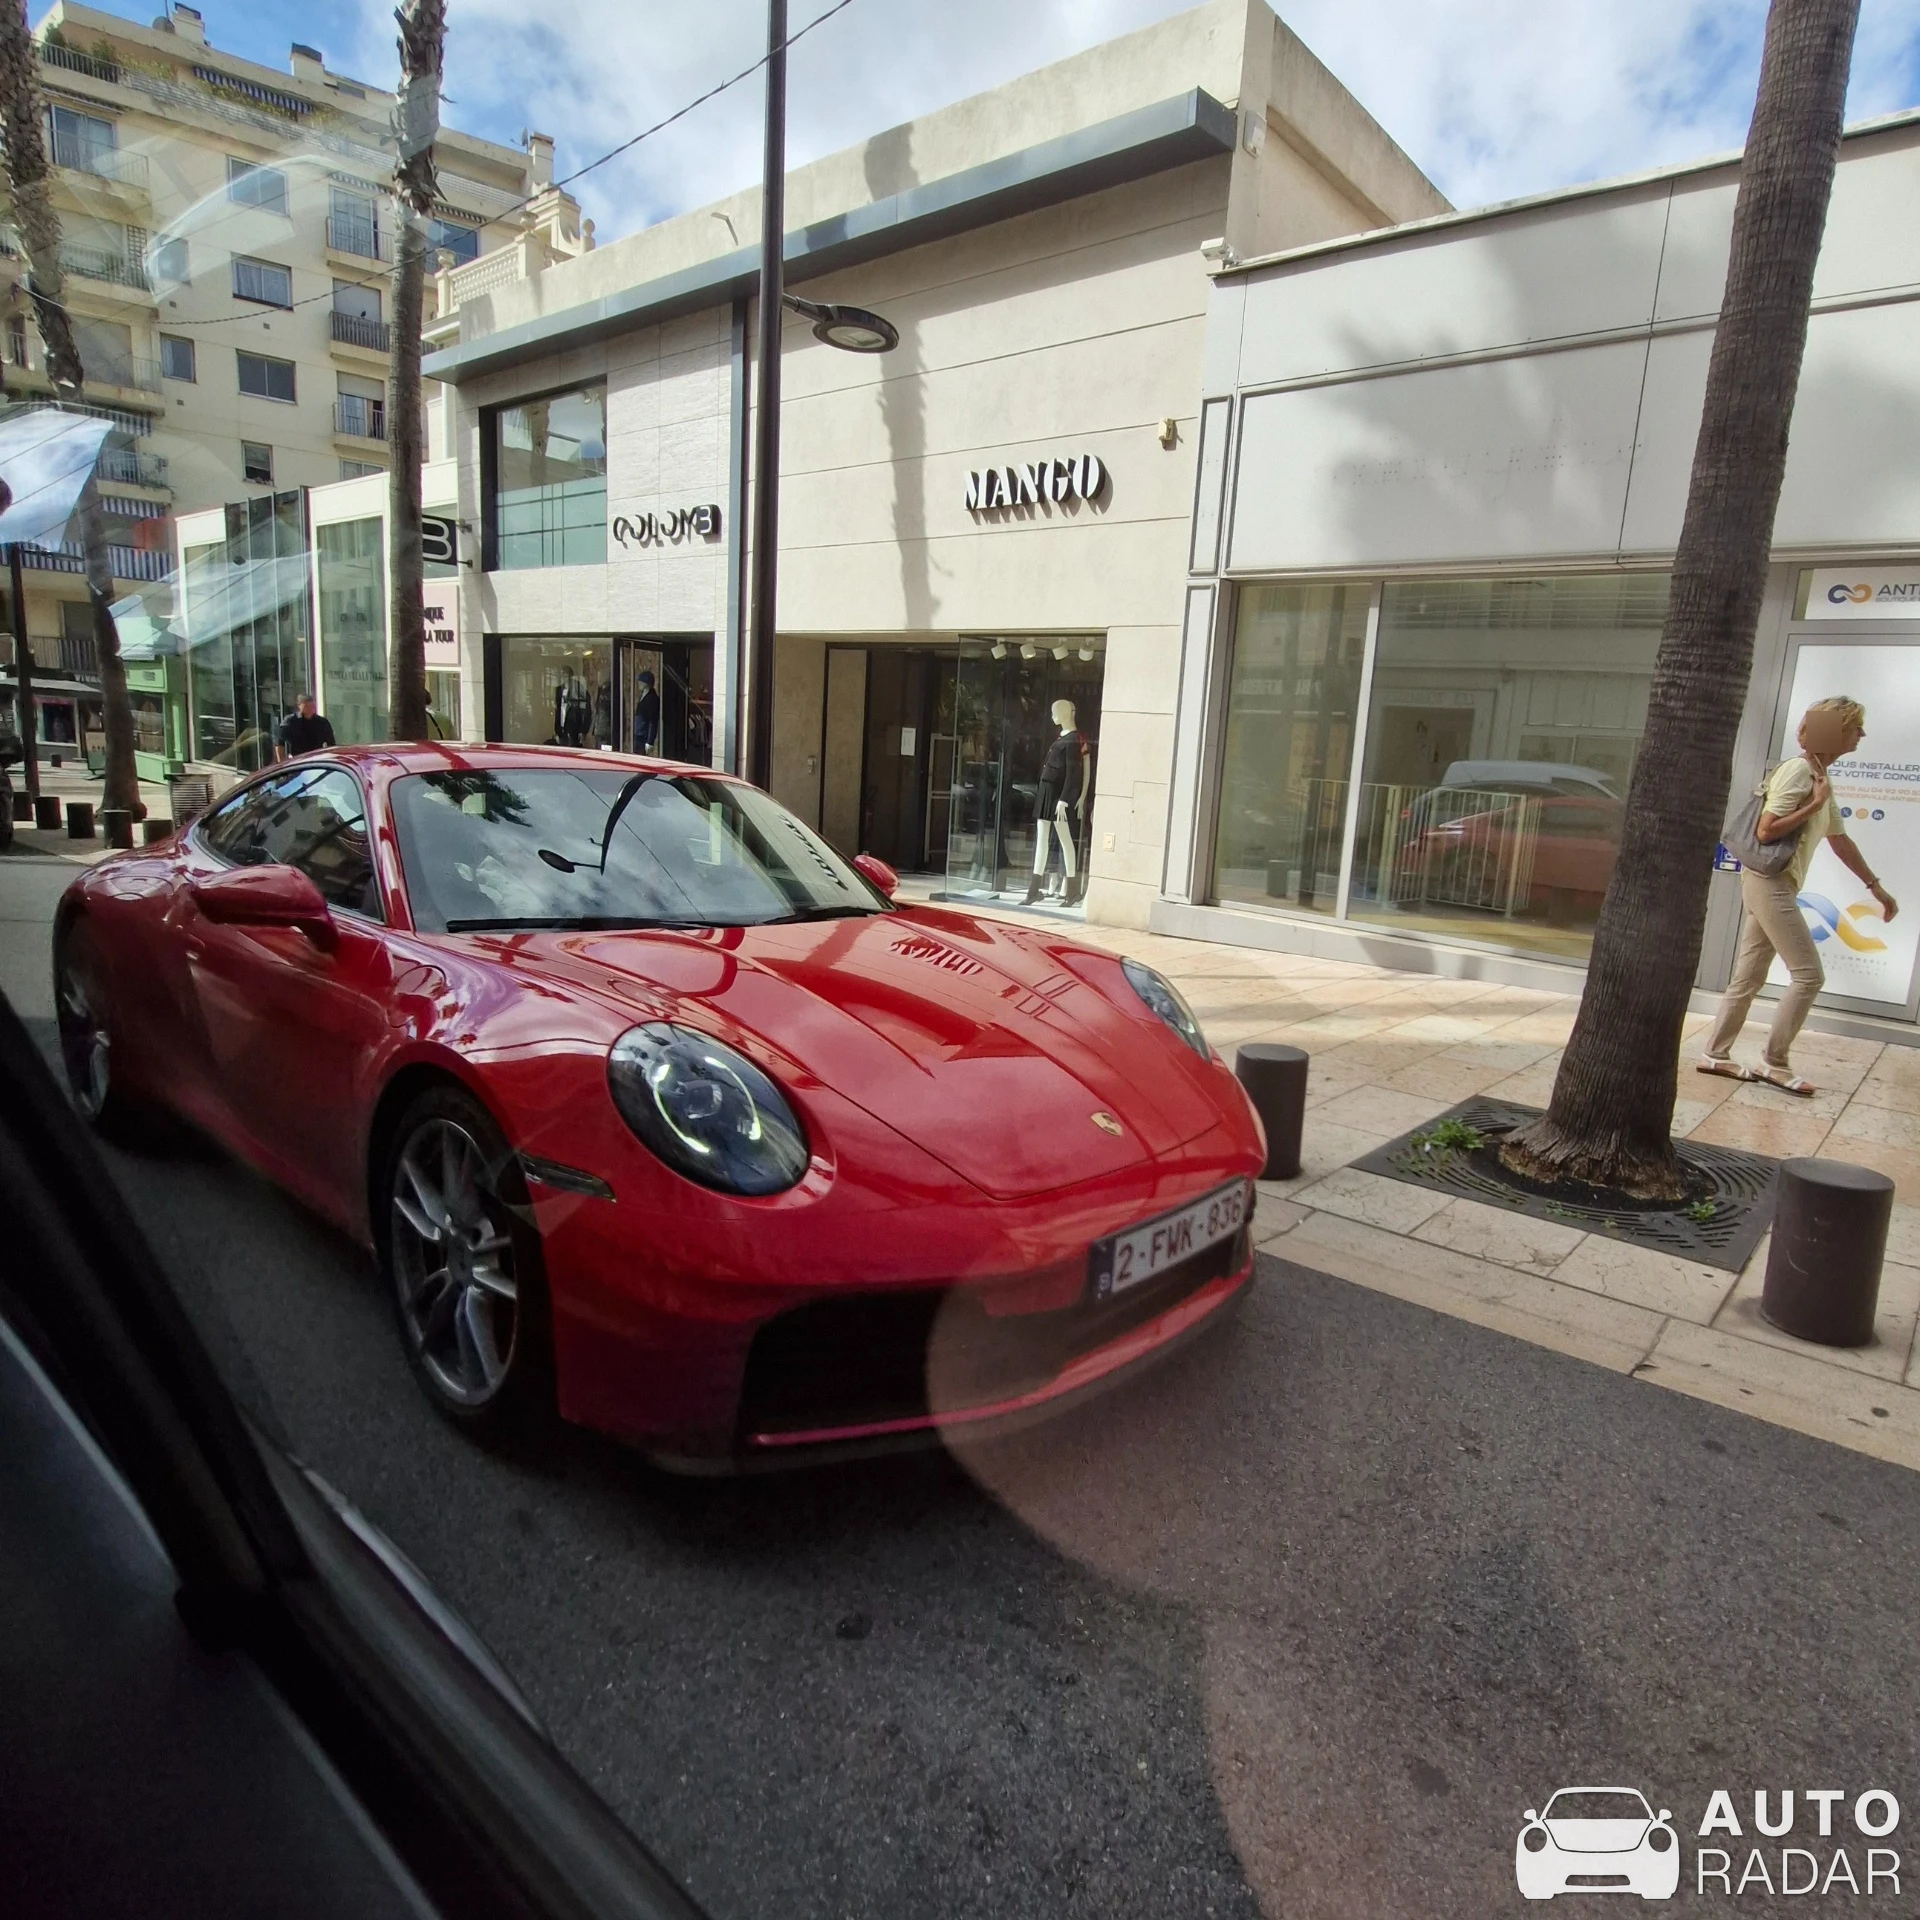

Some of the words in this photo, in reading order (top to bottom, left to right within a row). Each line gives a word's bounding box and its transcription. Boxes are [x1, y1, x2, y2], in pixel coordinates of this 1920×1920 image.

[964, 453, 1105, 510] MANGO
[1832, 760, 1857, 769] OUS
[1859, 762, 1920, 772] INSTALLER
[1828, 769, 1842, 777] EZ
[1844, 770, 1881, 779] VOTRE
